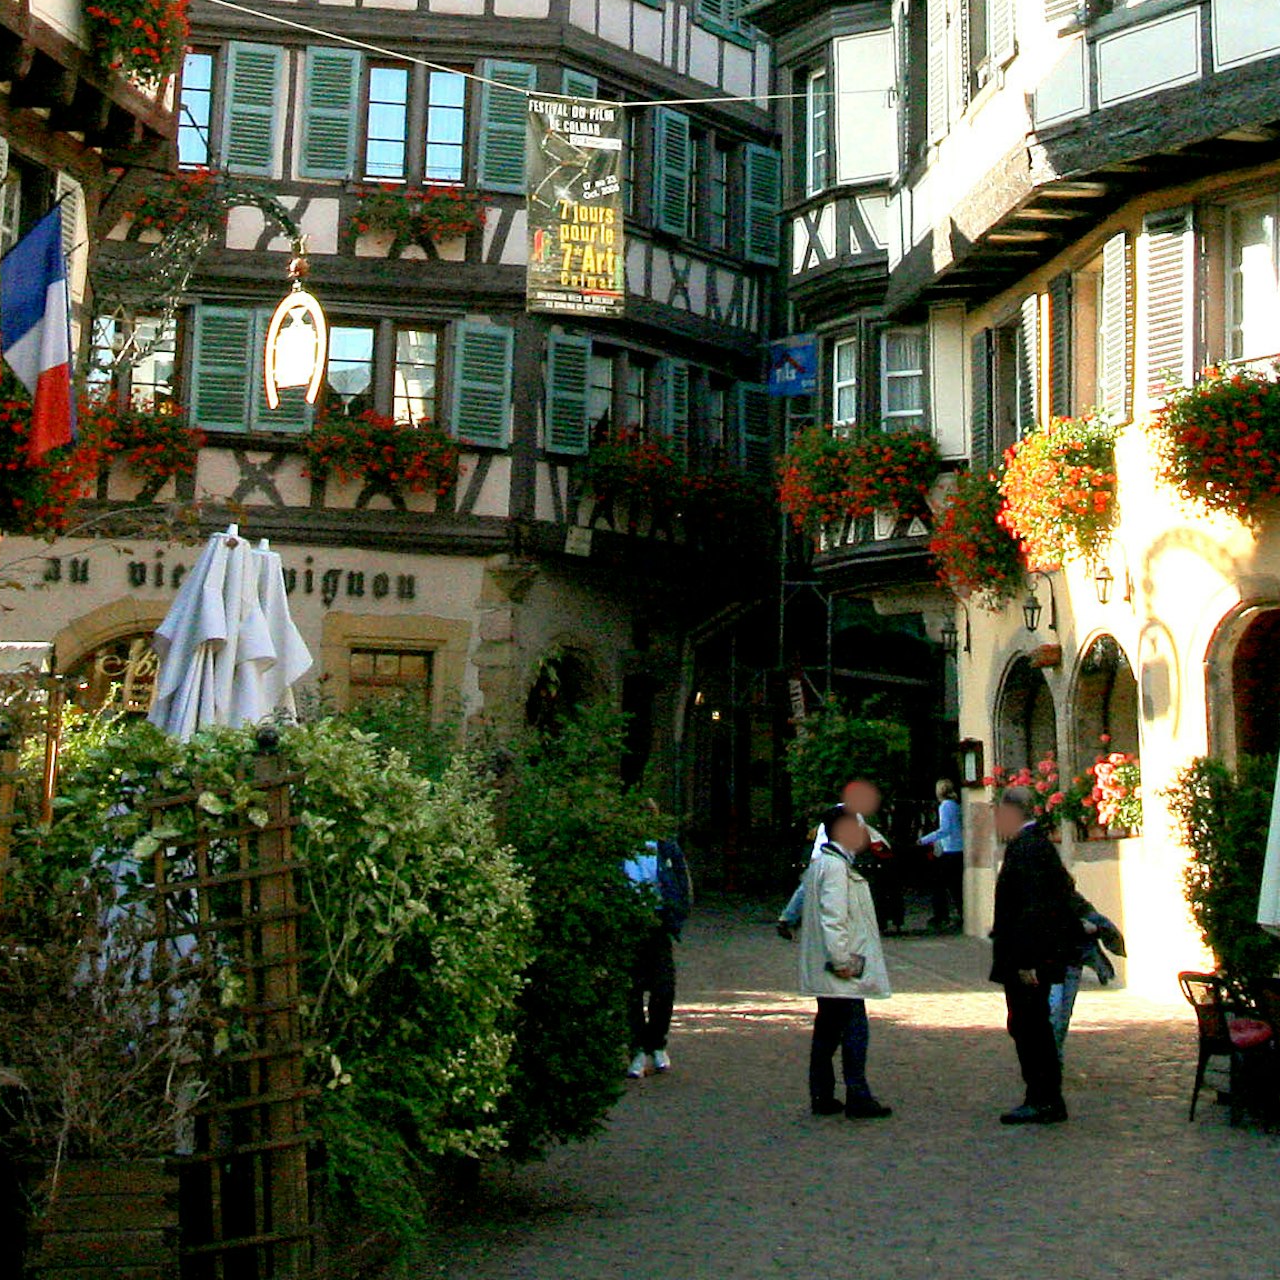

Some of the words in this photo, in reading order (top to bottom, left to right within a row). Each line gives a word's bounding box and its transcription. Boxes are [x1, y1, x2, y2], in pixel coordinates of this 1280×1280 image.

[528, 99, 569, 118] FESTIVAL
[571, 104, 587, 120] DU
[589, 107, 615, 122] FILM
[563, 120, 601, 137] COLMAR
[559, 199, 570, 220] 7
[572, 200, 615, 225] jours
[560, 223, 598, 244] pour
[600, 223, 615, 246] le
[582, 244, 615, 276] Art
[43, 556, 89, 583] au
